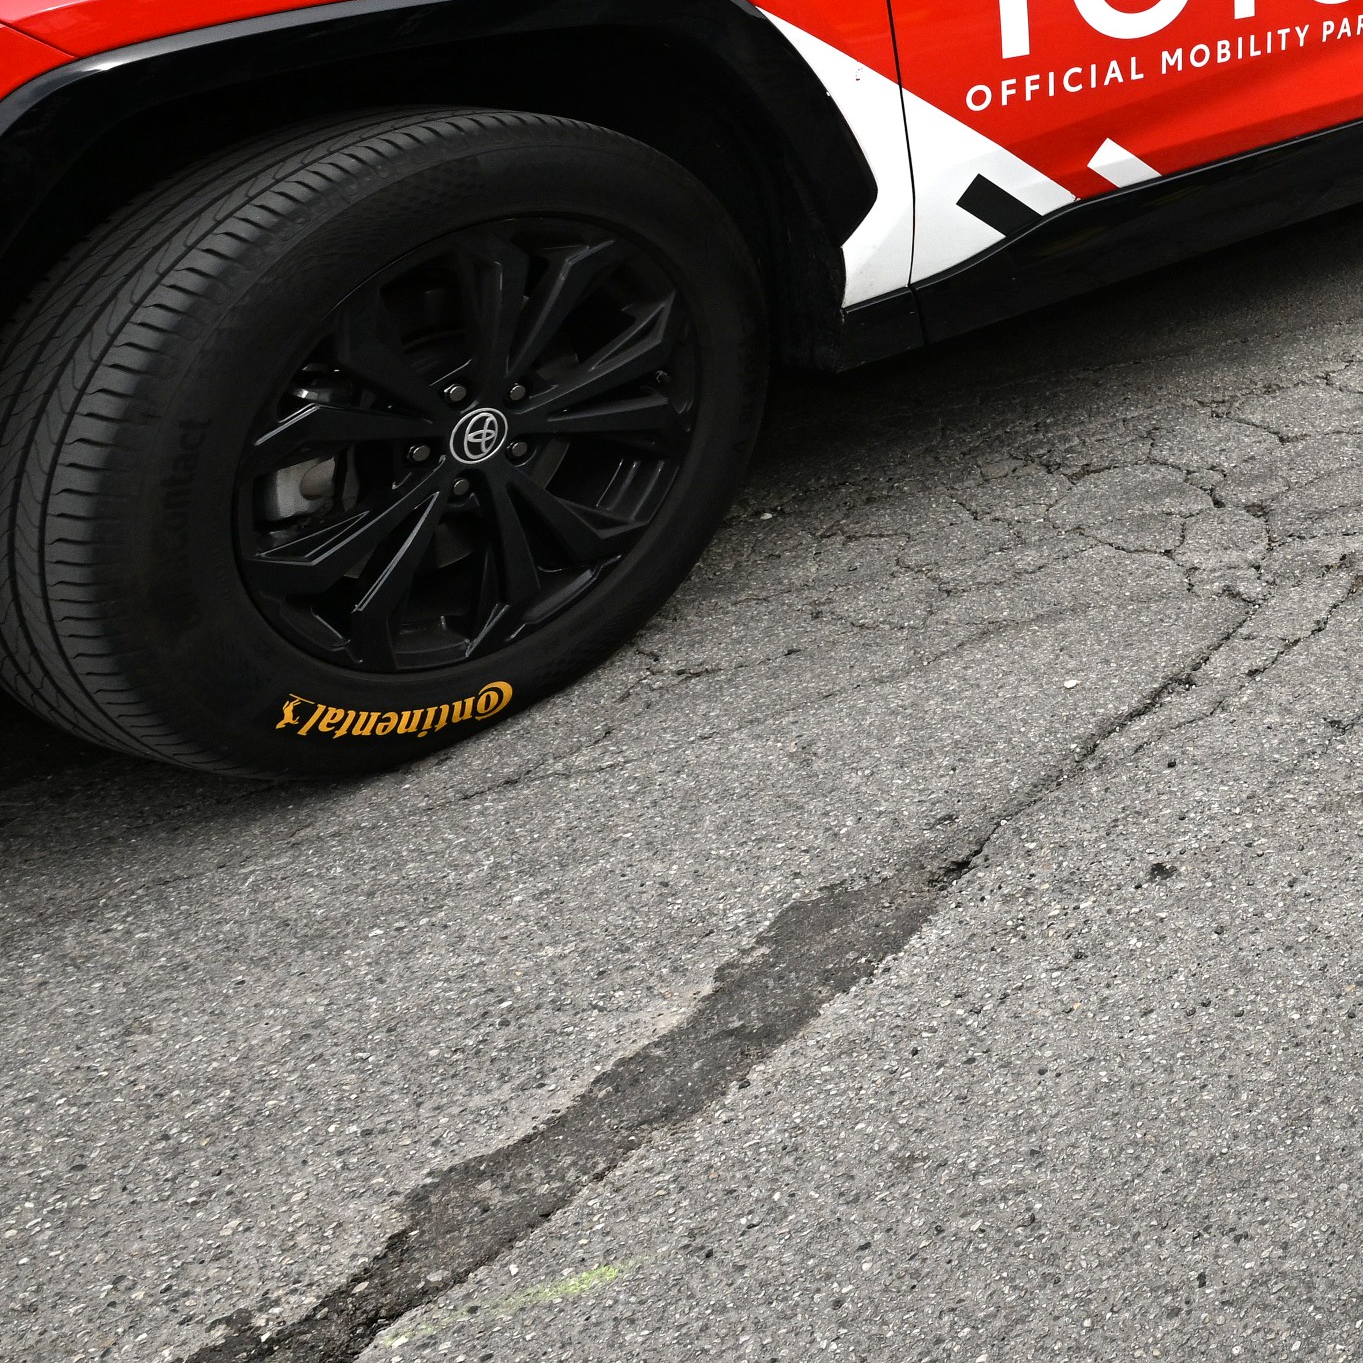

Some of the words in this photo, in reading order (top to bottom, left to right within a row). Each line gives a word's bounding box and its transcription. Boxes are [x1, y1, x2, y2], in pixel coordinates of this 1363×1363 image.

[965, 54, 1146, 113] OFFICIAL
[1160, 23, 1312, 75] MOBILITY
[297, 680, 514, 742] Continental
